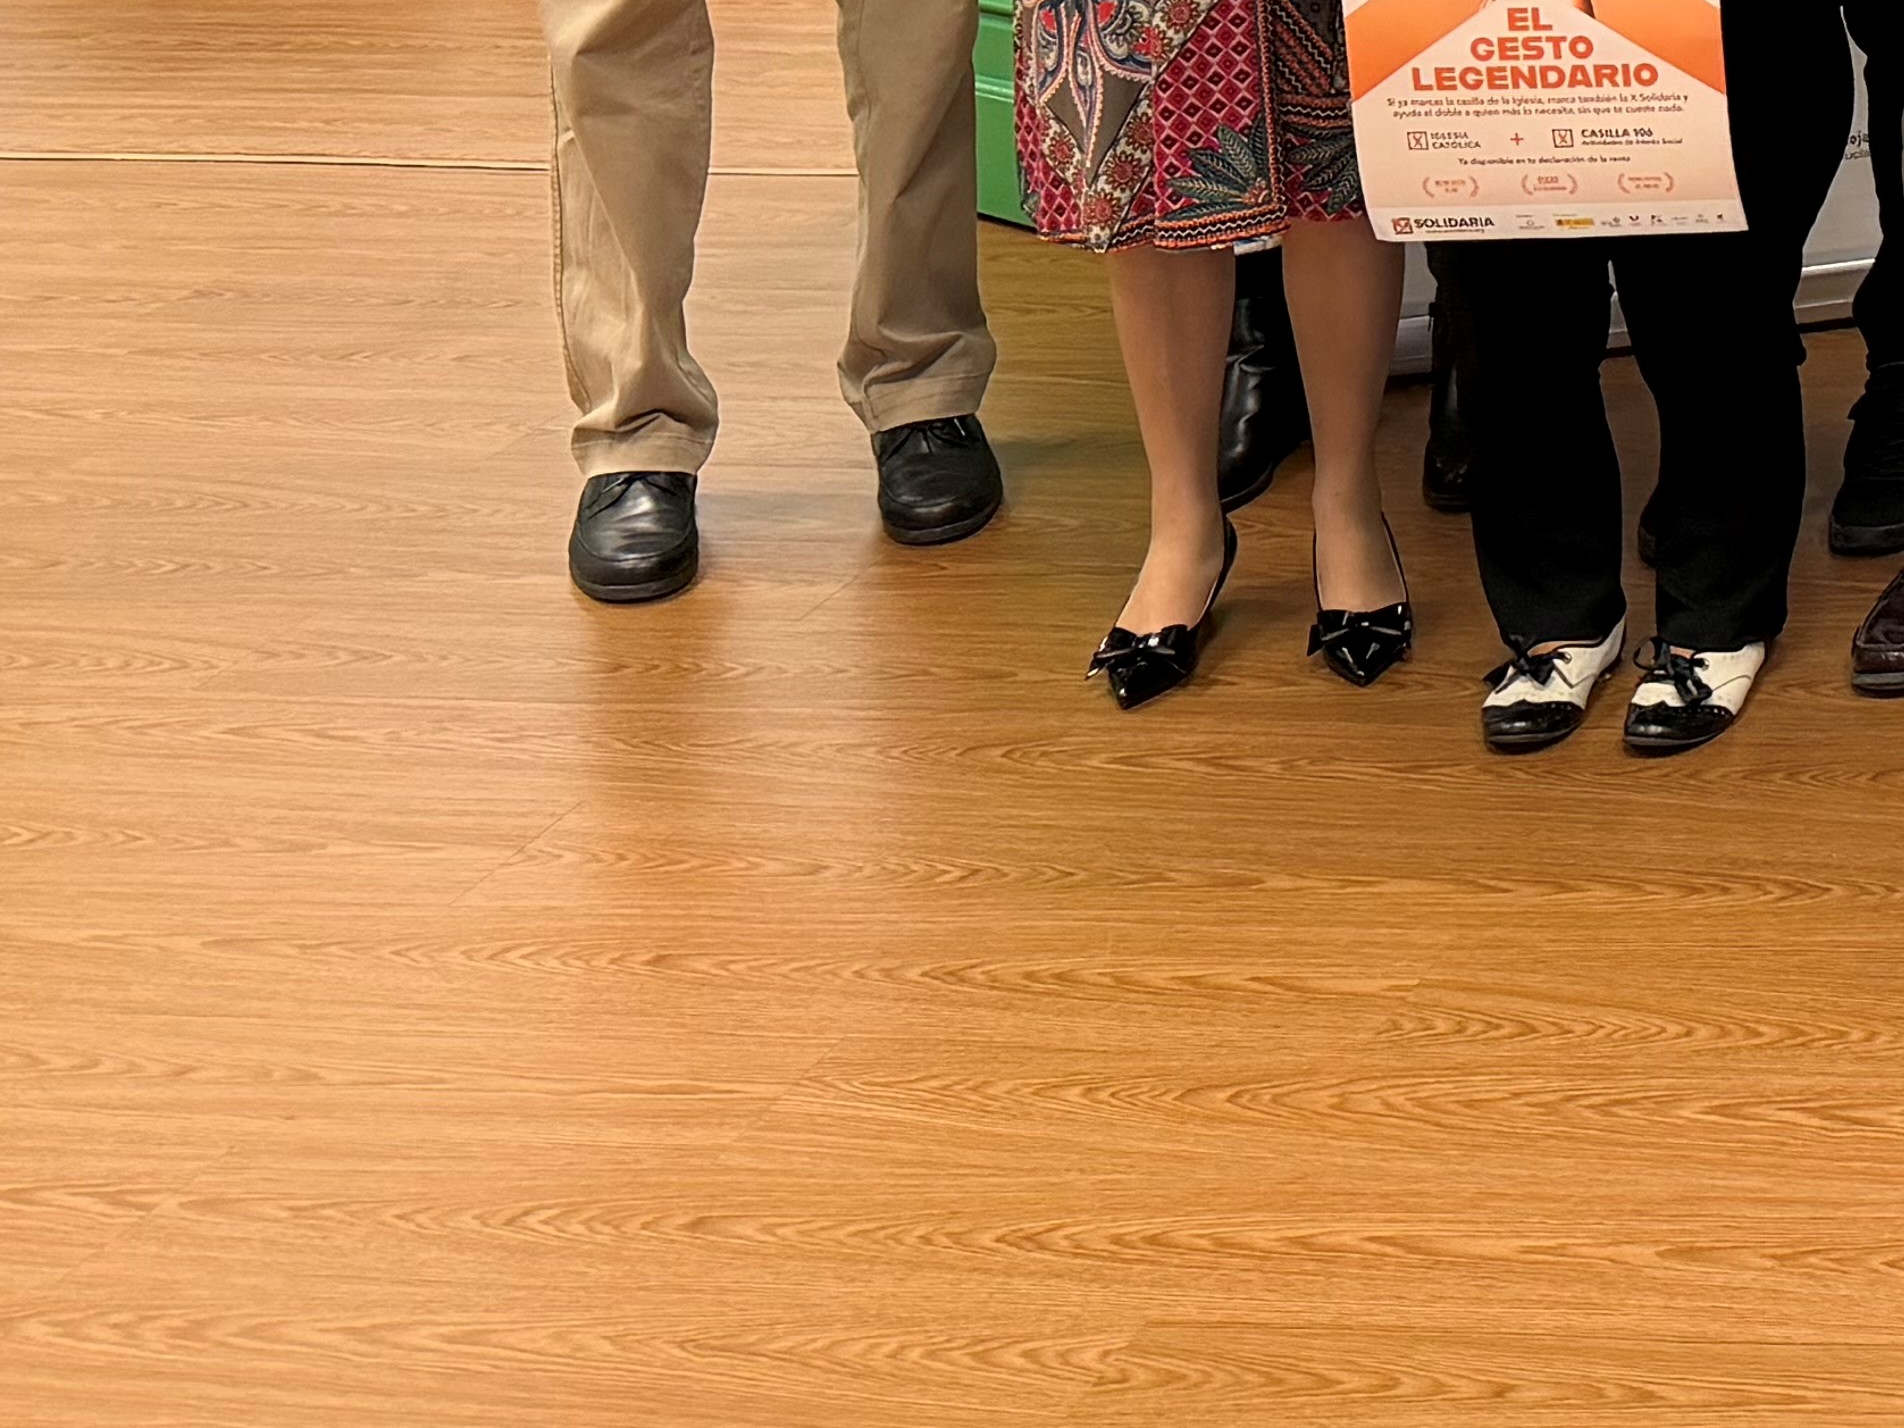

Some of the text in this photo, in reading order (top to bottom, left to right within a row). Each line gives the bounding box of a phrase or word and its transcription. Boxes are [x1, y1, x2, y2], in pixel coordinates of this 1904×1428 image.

[1507, 7, 1552, 30] EL
[1469, 35, 1594, 60] GESTO
[1411, 63, 1658, 91] LEGENDARIO
[1415, 217, 1493, 229] SOLIDARIA
